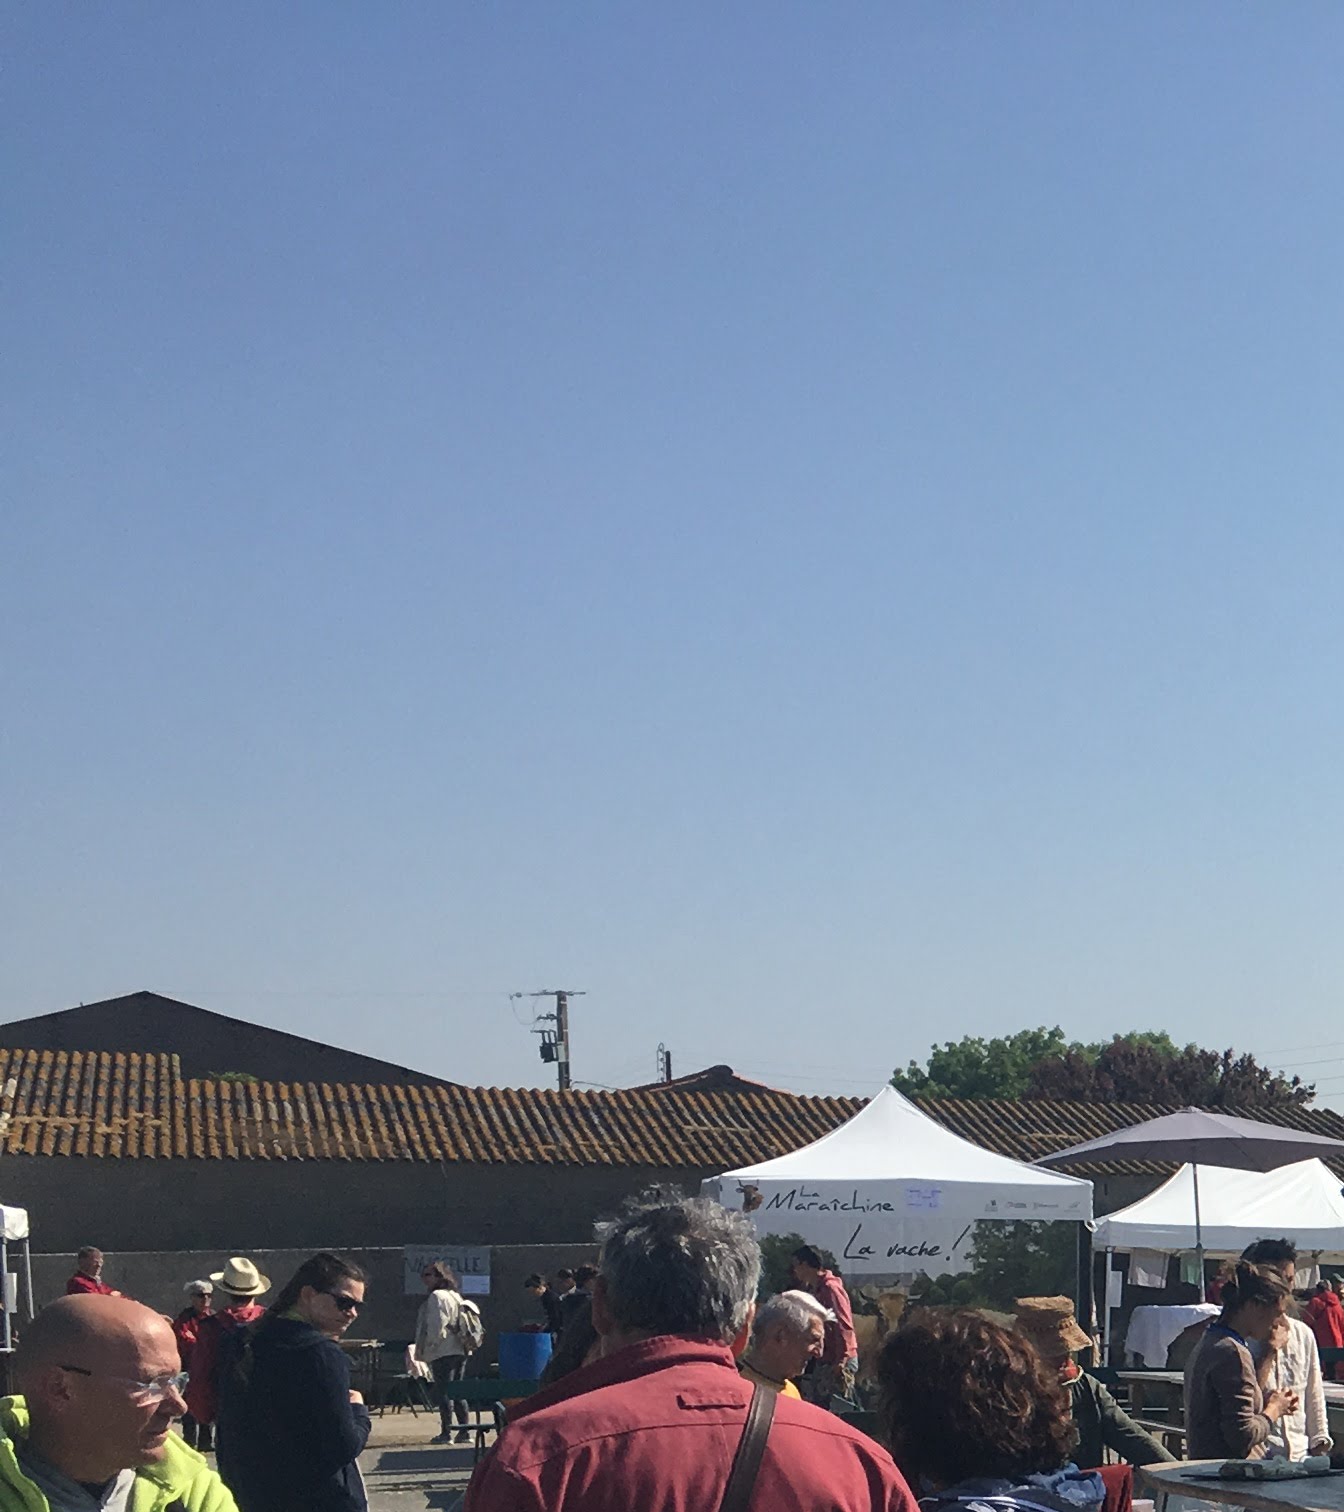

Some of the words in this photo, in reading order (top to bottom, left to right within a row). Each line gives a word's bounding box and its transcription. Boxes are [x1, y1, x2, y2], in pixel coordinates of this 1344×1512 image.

[766, 1189, 895, 1213] Maraîchine
[799, 1185, 819, 1198] La
[844, 1223, 875, 1260] La
